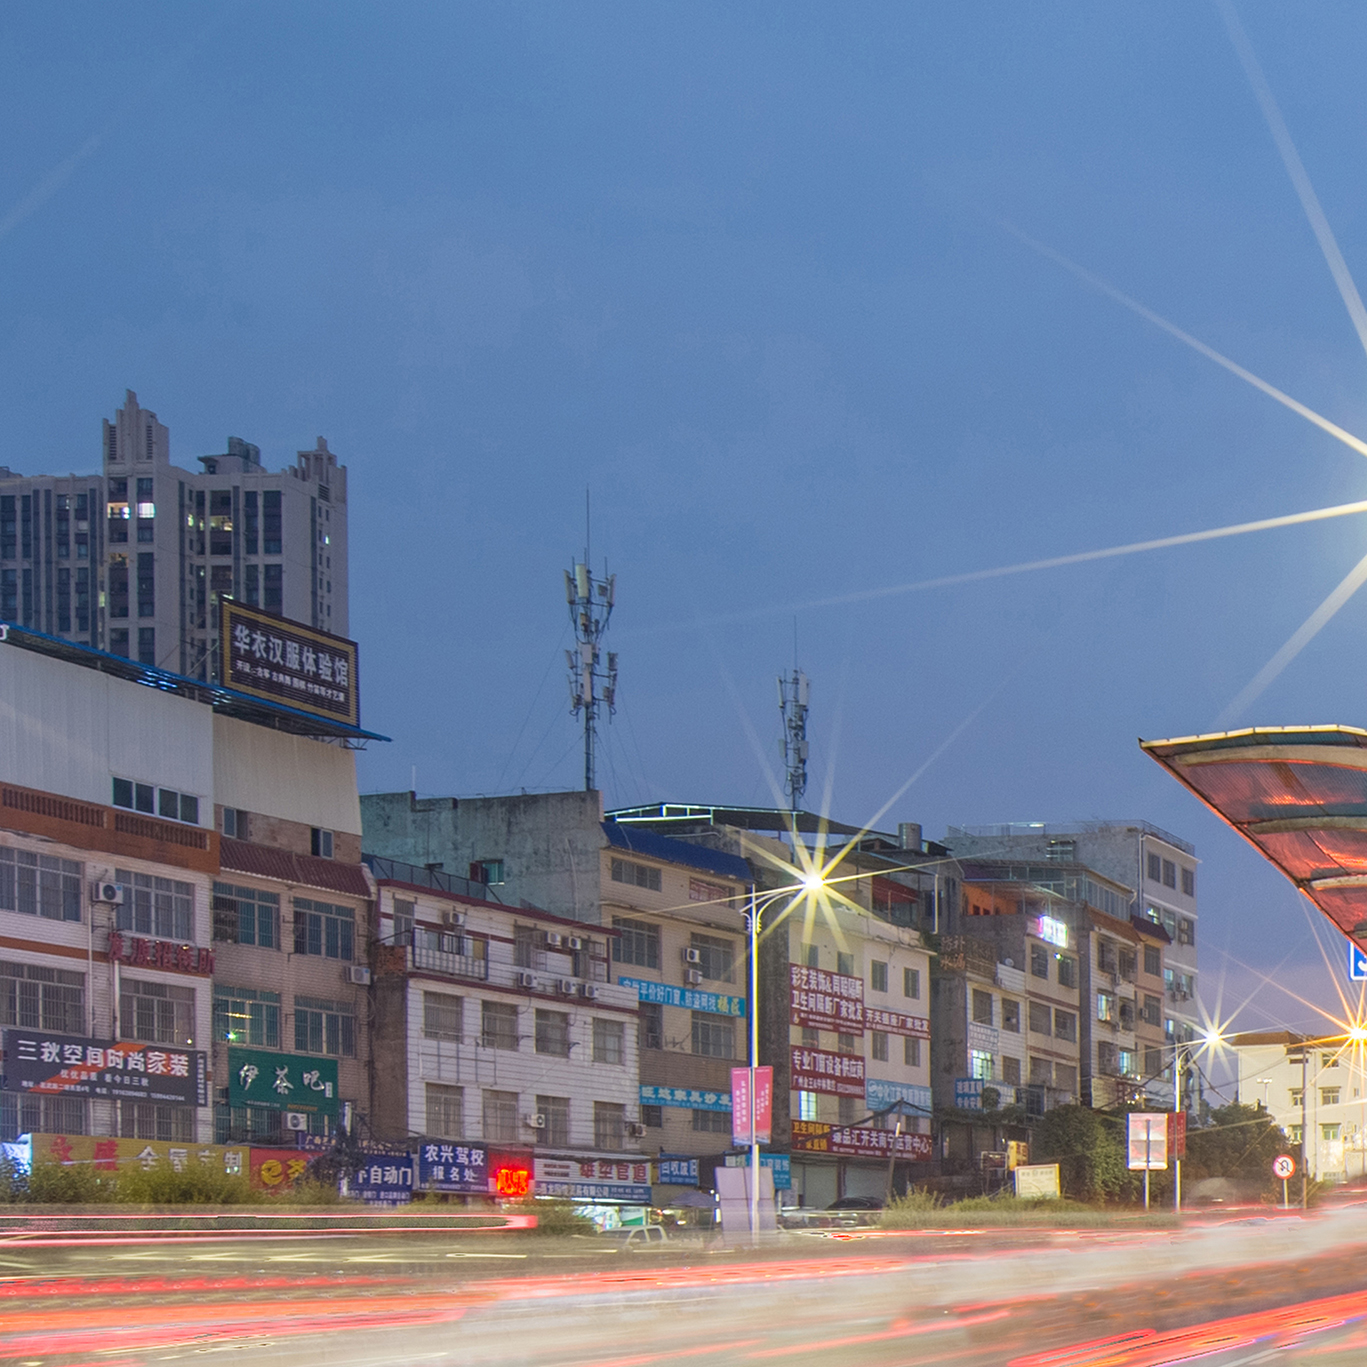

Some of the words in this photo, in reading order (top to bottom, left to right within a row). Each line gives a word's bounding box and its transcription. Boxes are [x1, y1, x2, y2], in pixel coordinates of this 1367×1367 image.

[17, 1039, 190, 1077] 三秋空间时尚家装
[425, 1144, 485, 1167] 农兴驾校
